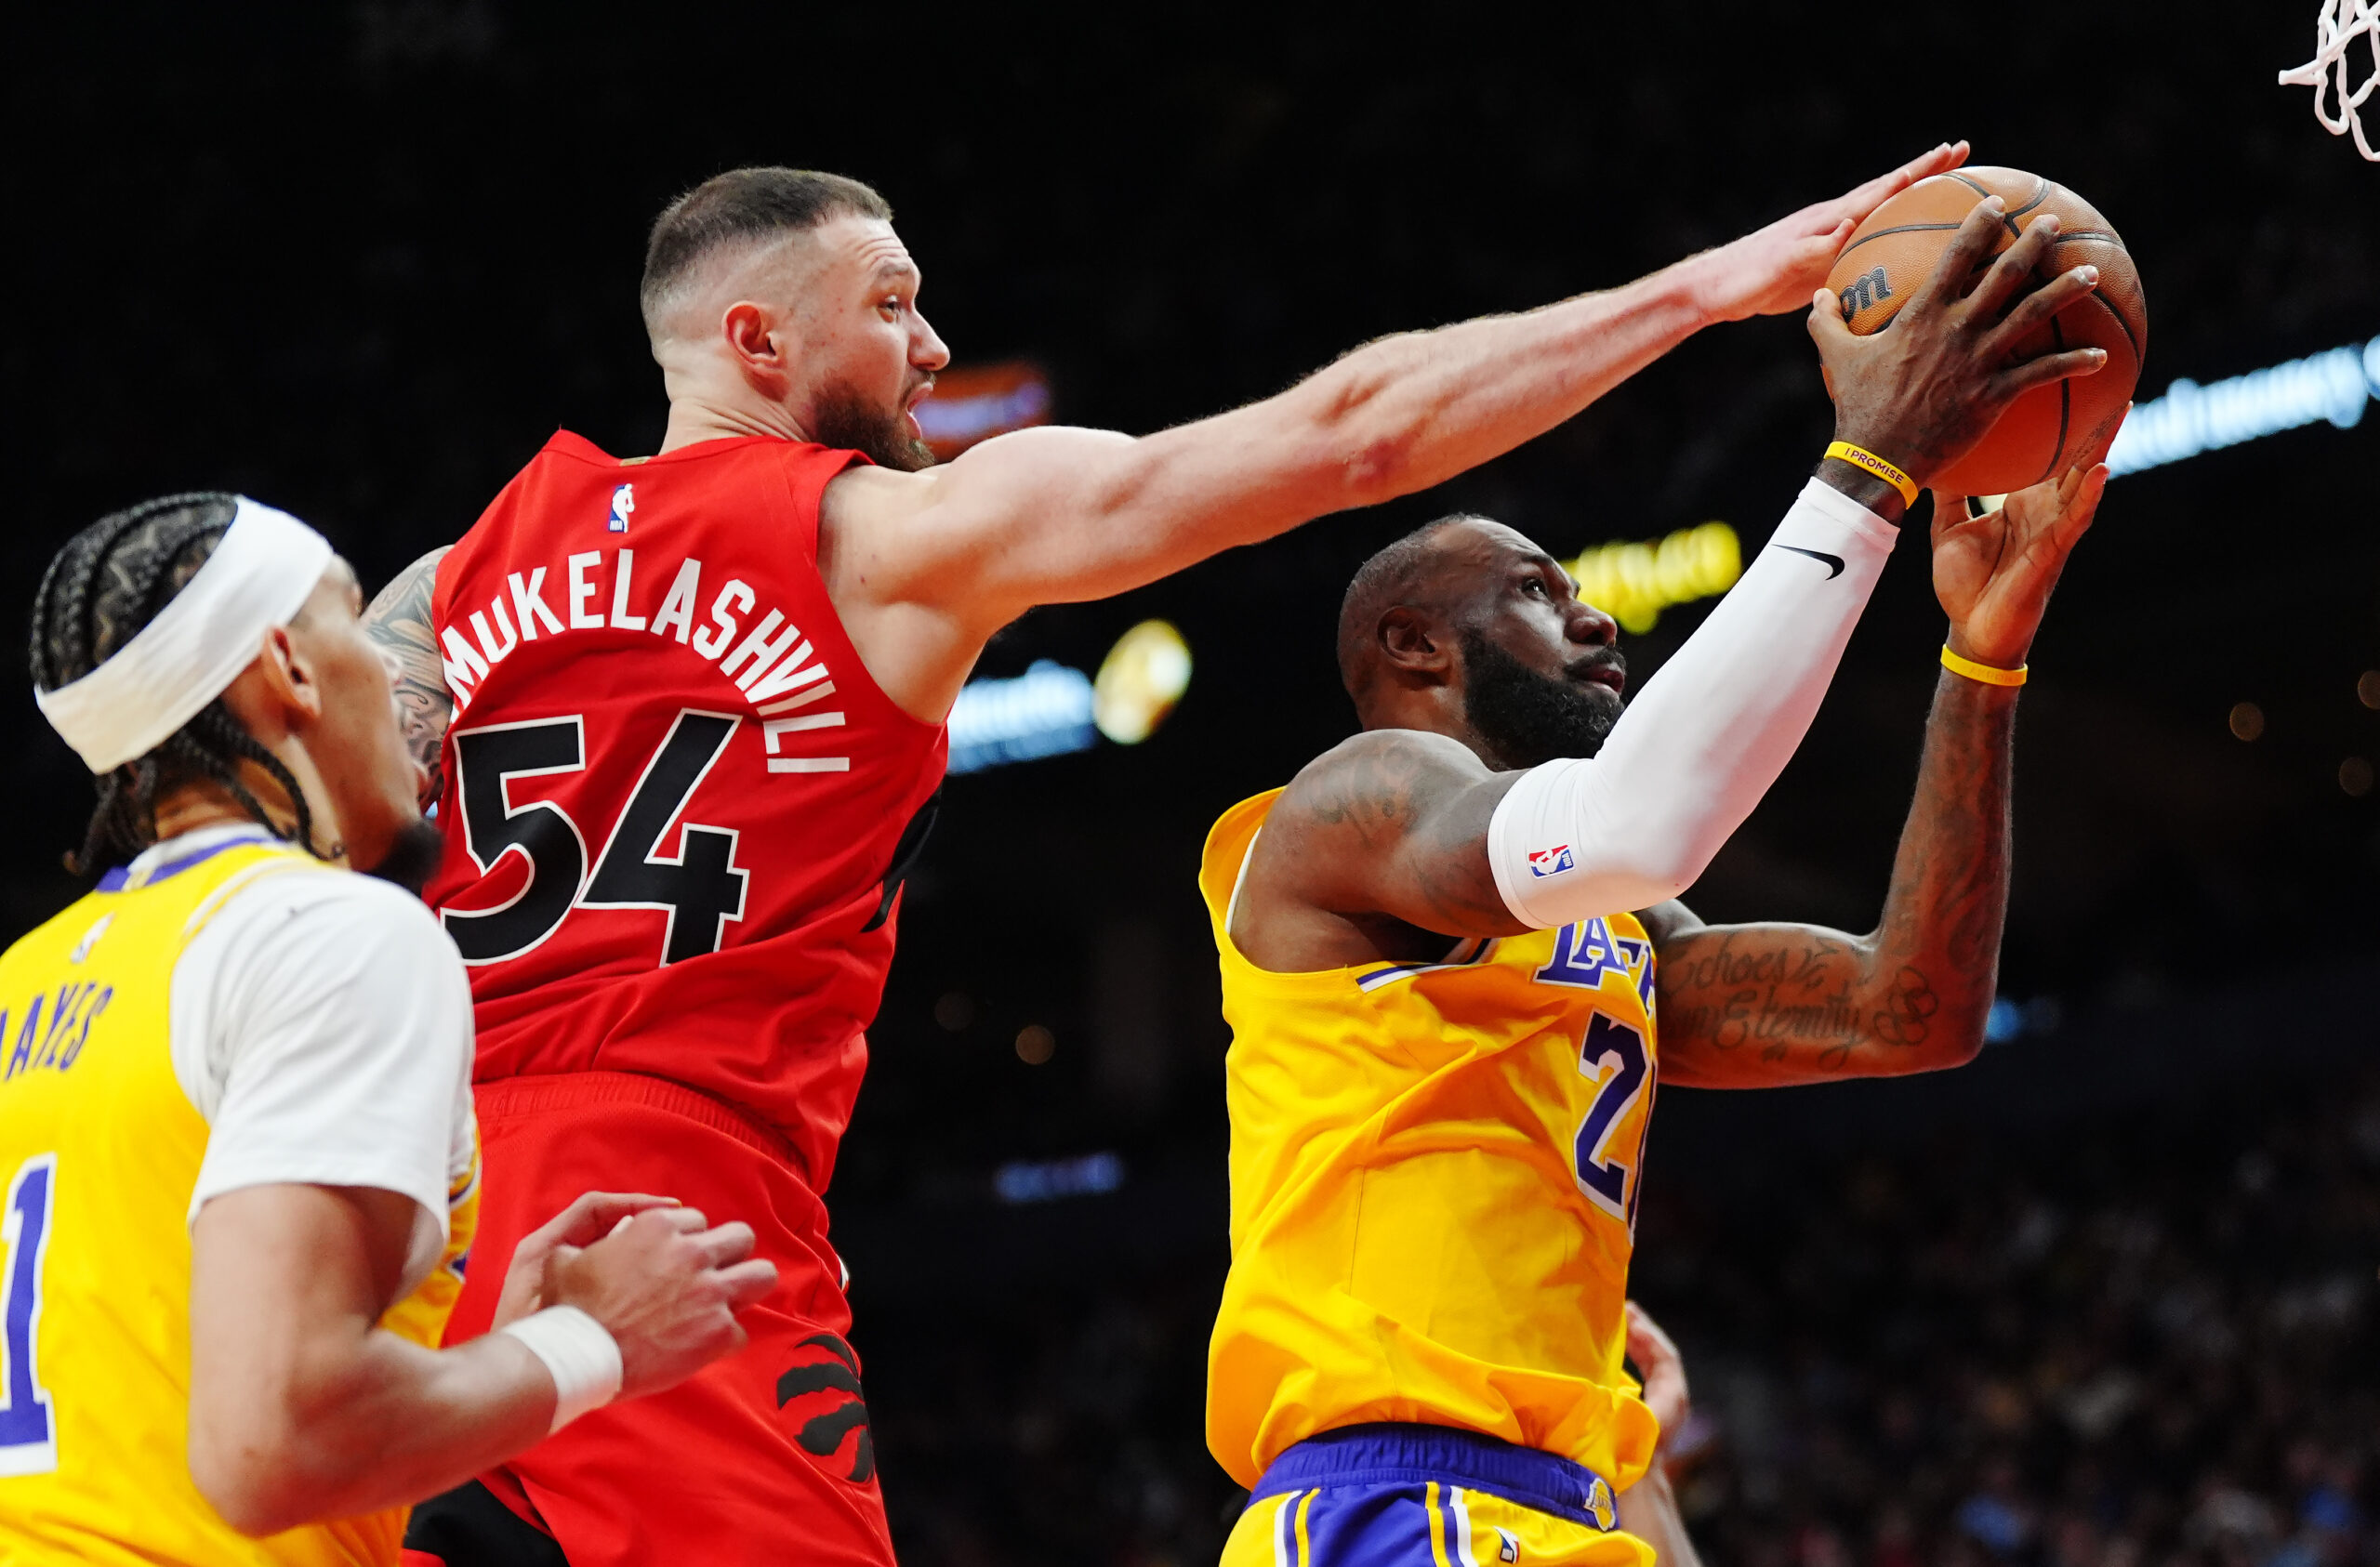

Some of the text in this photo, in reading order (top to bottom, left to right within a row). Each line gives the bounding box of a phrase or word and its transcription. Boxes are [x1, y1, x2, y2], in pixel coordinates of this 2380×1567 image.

[1844, 447, 1904, 484] I PROMISE
[441, 548, 850, 772] MUKELASHVILI
[441, 707, 749, 968] 54
[0, 981, 113, 1084] AYES
